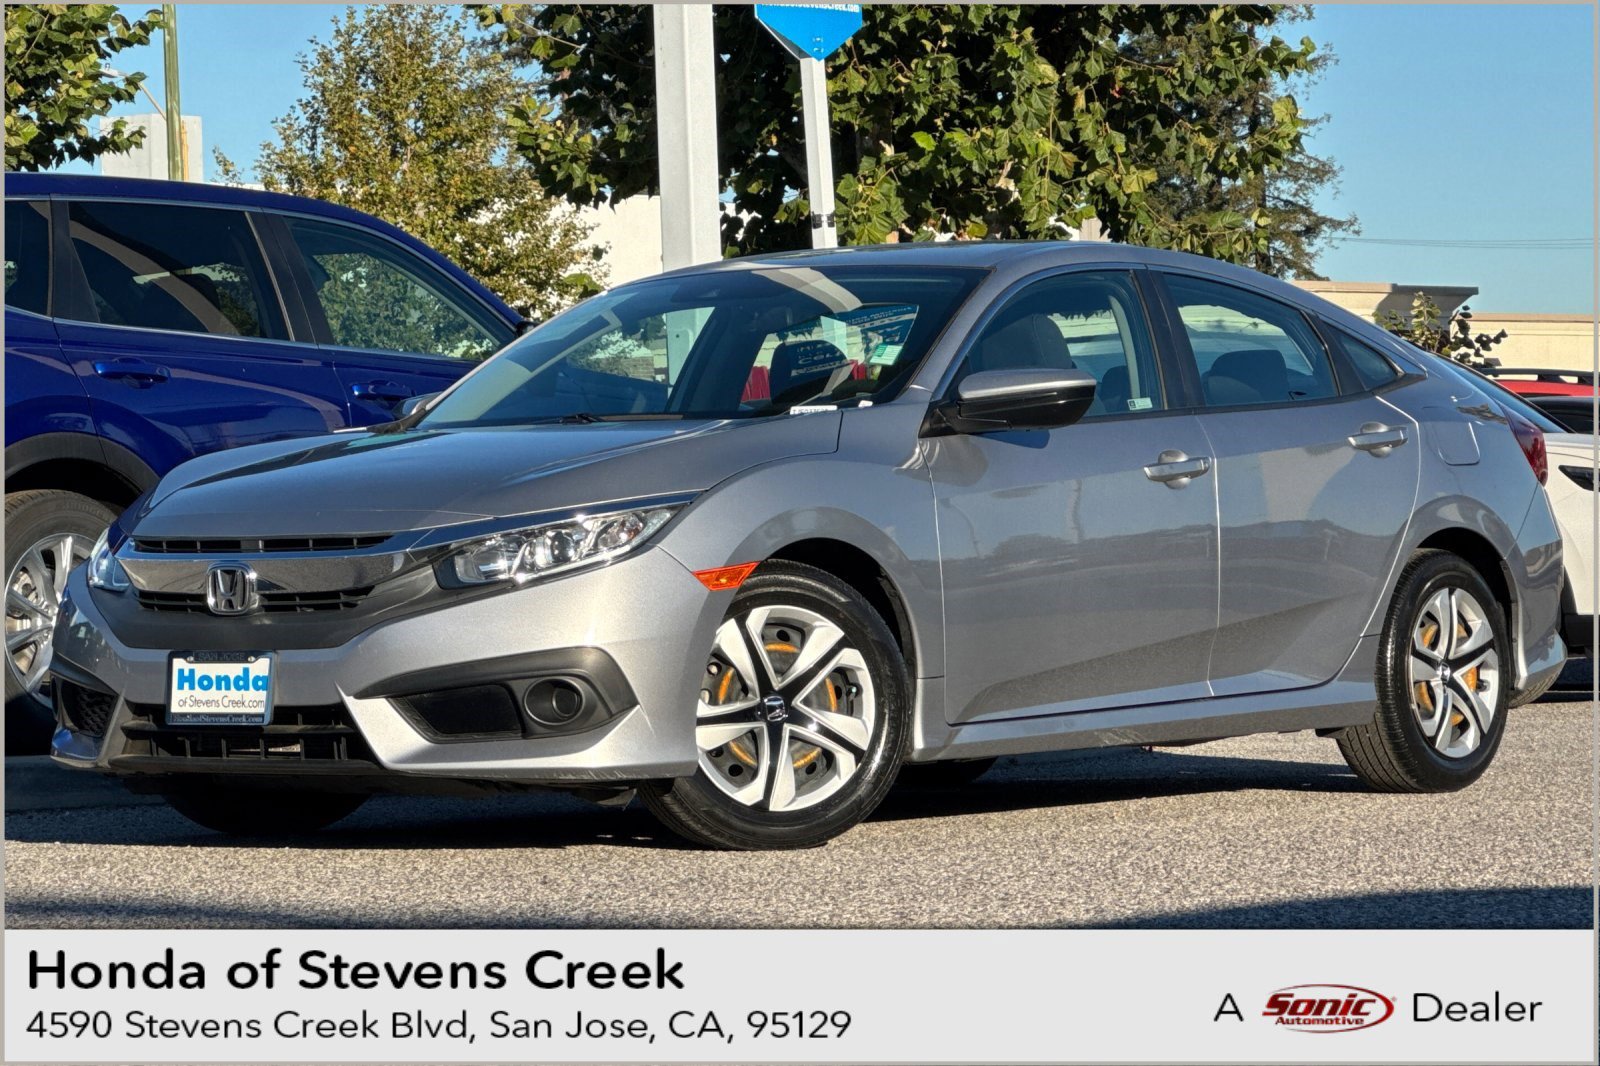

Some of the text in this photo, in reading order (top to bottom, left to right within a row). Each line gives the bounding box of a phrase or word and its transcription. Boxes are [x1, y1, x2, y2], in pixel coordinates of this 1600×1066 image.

[177, 667, 269, 691] Honda
[178, 694, 265, 708] of Stevens Creek.com
